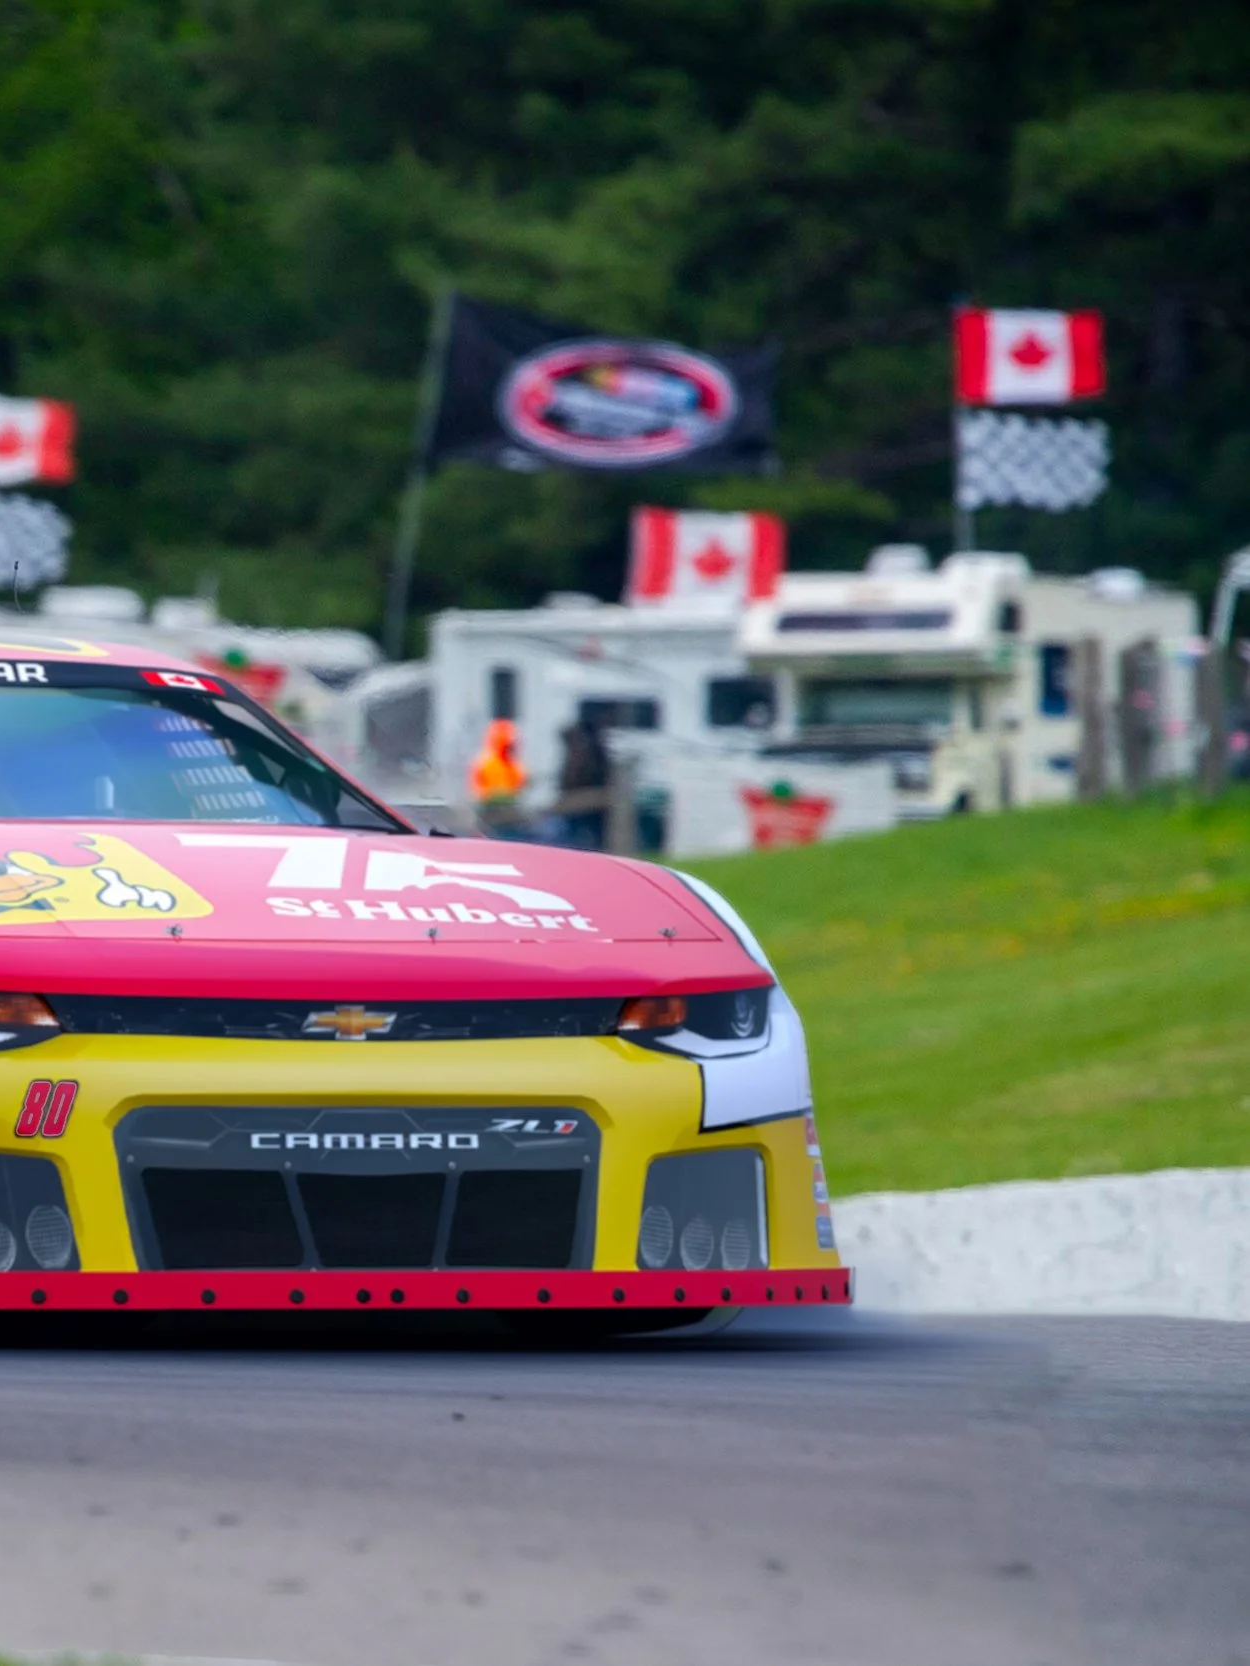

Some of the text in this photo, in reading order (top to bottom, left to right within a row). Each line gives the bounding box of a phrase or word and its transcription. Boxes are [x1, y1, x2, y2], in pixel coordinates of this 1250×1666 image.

[266, 896, 599, 932] St Hubert
[14, 1079, 79, 1139] 80
[485, 1118, 579, 1135] ZL1
[250, 1132, 480, 1150] CAMARO
